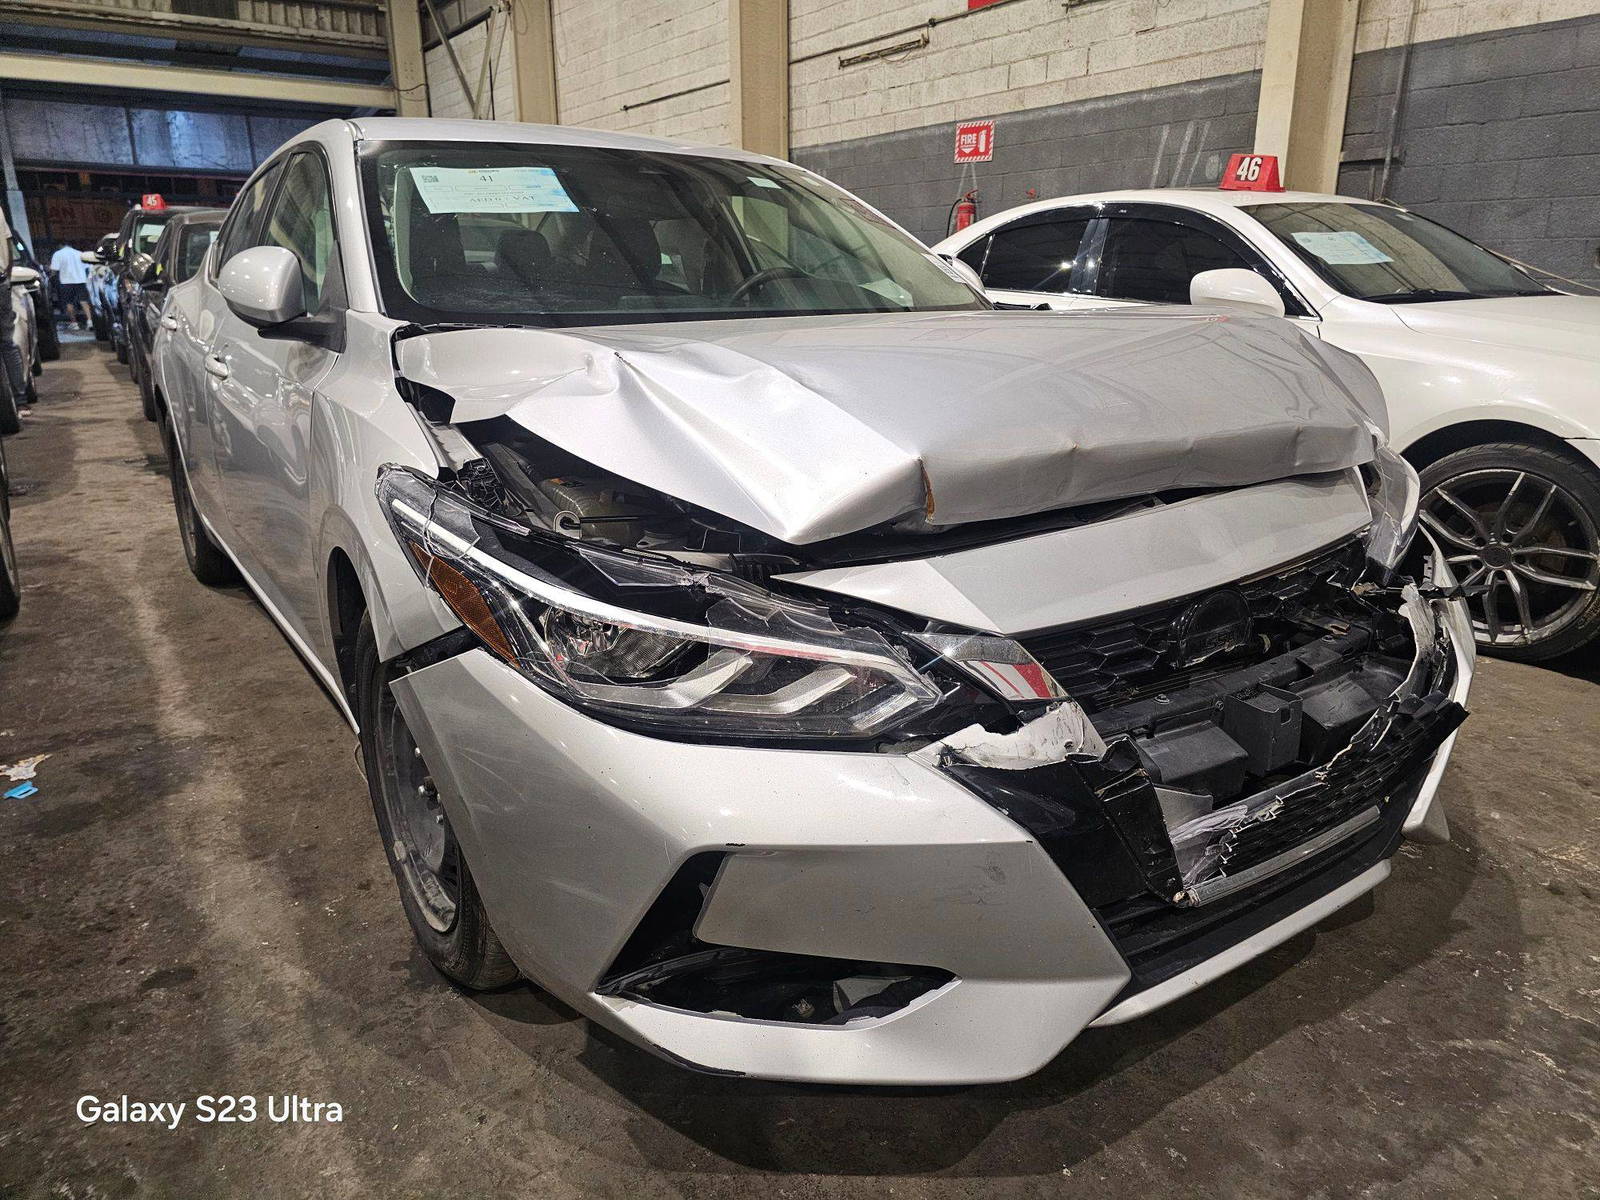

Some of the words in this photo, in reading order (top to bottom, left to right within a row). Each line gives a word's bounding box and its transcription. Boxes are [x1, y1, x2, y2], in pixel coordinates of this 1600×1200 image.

[960, 133, 977, 145] FIRE
[1236, 156, 1263, 181] 46
[146, 195, 158, 207] 45
